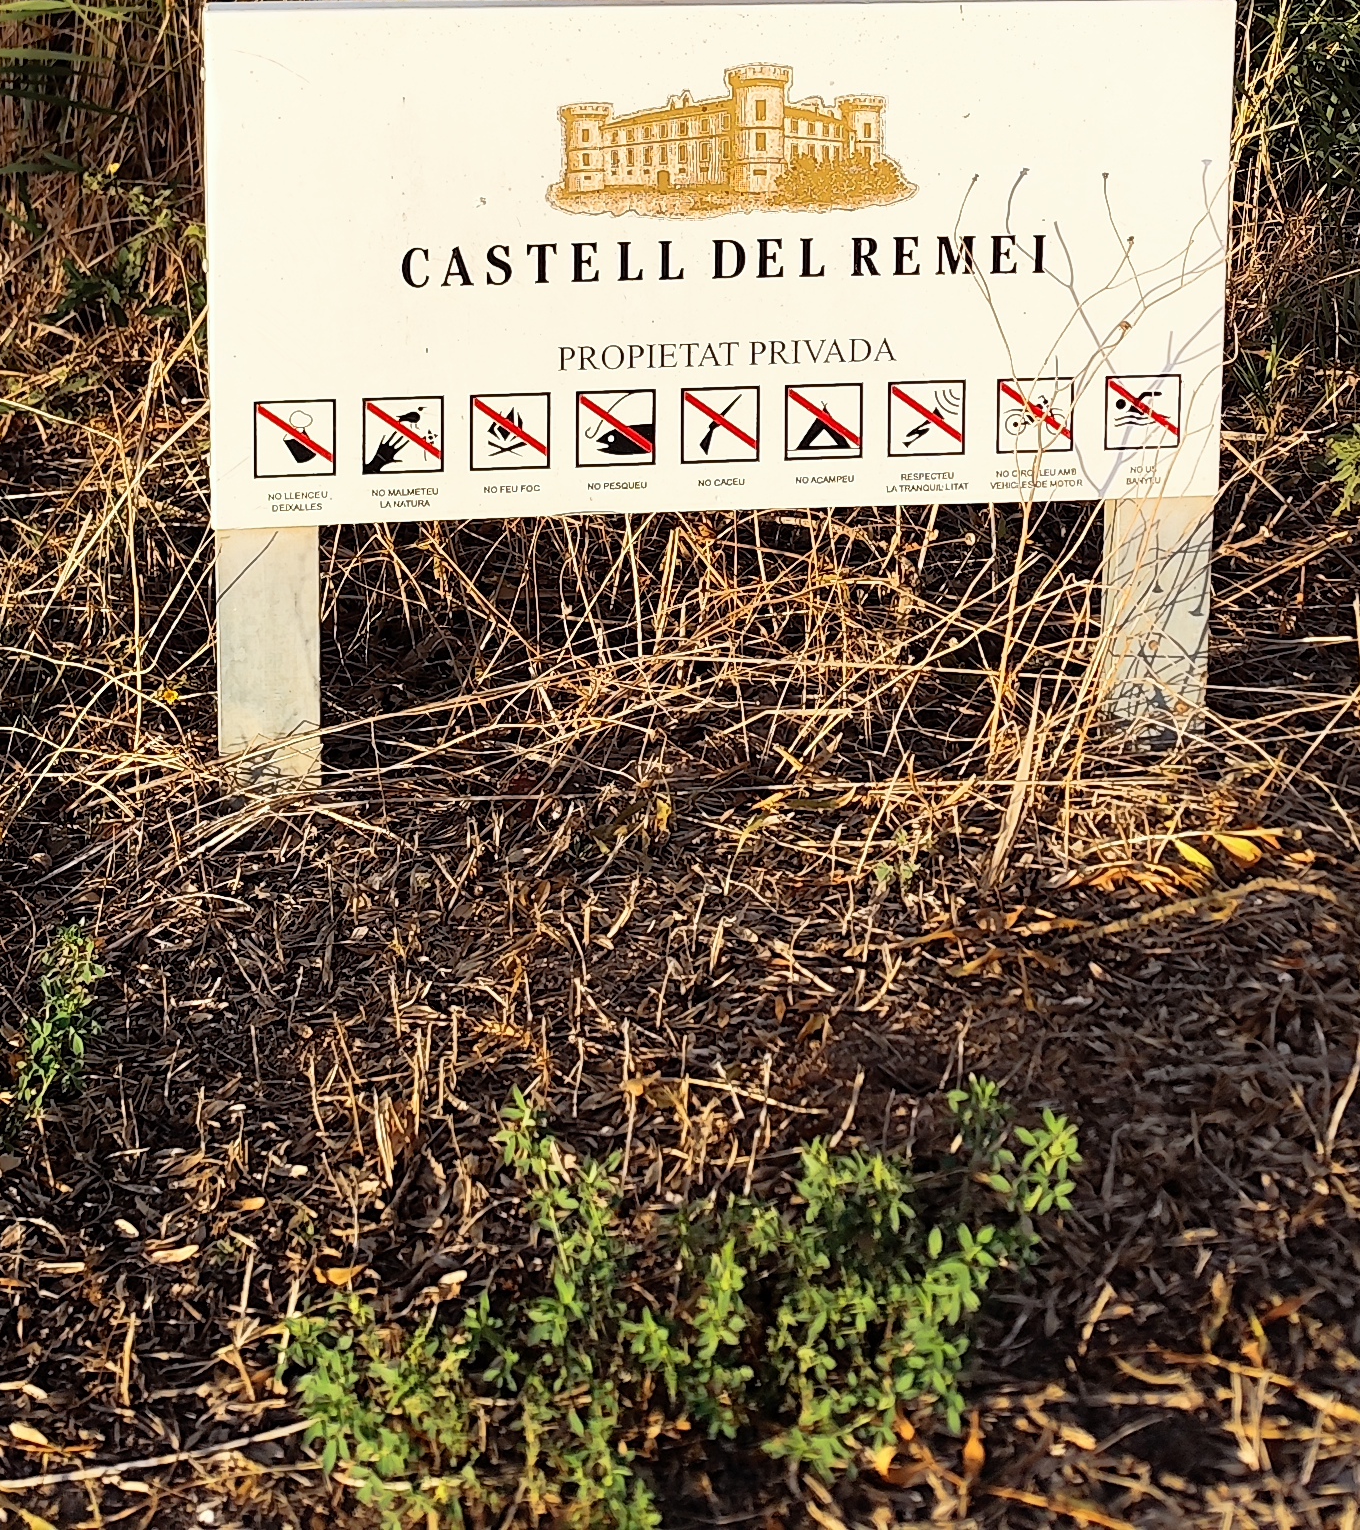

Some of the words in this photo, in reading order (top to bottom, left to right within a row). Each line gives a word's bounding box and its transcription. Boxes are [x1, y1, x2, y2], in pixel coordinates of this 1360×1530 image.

[401, 241, 685, 289] CASTELL
[712, 236, 826, 281] DEL
[850, 234, 1047, 278] REMEI
[558, 340, 740, 372] PROPIETAT
[749, 337, 896, 368] PRIVADA
[995, 469, 1010, 478] NO
[1057, 467, 1077, 476] AMB
[1130, 465, 1144, 474] NO
[795, 476, 809, 485] NO
[810, 474, 855, 484] ACAMPEU
[900, 471, 955, 481] RESPECTEU
[587, 482, 602, 491] NO
[603, 481, 648, 490] PESQUEU
[697, 479, 712, 487] NO
[713, 478, 746, 487] CACEU
[1049, 478, 1083, 488] MOTOR
[371, 488, 386, 497] NO
[387, 487, 440, 497] MALMETEU
[483, 485, 498, 494] NO
[499, 484, 519, 494] FEU
[520, 484, 541, 493] FOC
[886, 484, 898, 493] LA
[267, 492, 282, 501] NO
[283, 490, 329, 501] LLENCEU
[271, 502, 323, 513] DEIXALLES
[379, 499, 392, 509] LA
[393, 499, 431, 508] NATURA
